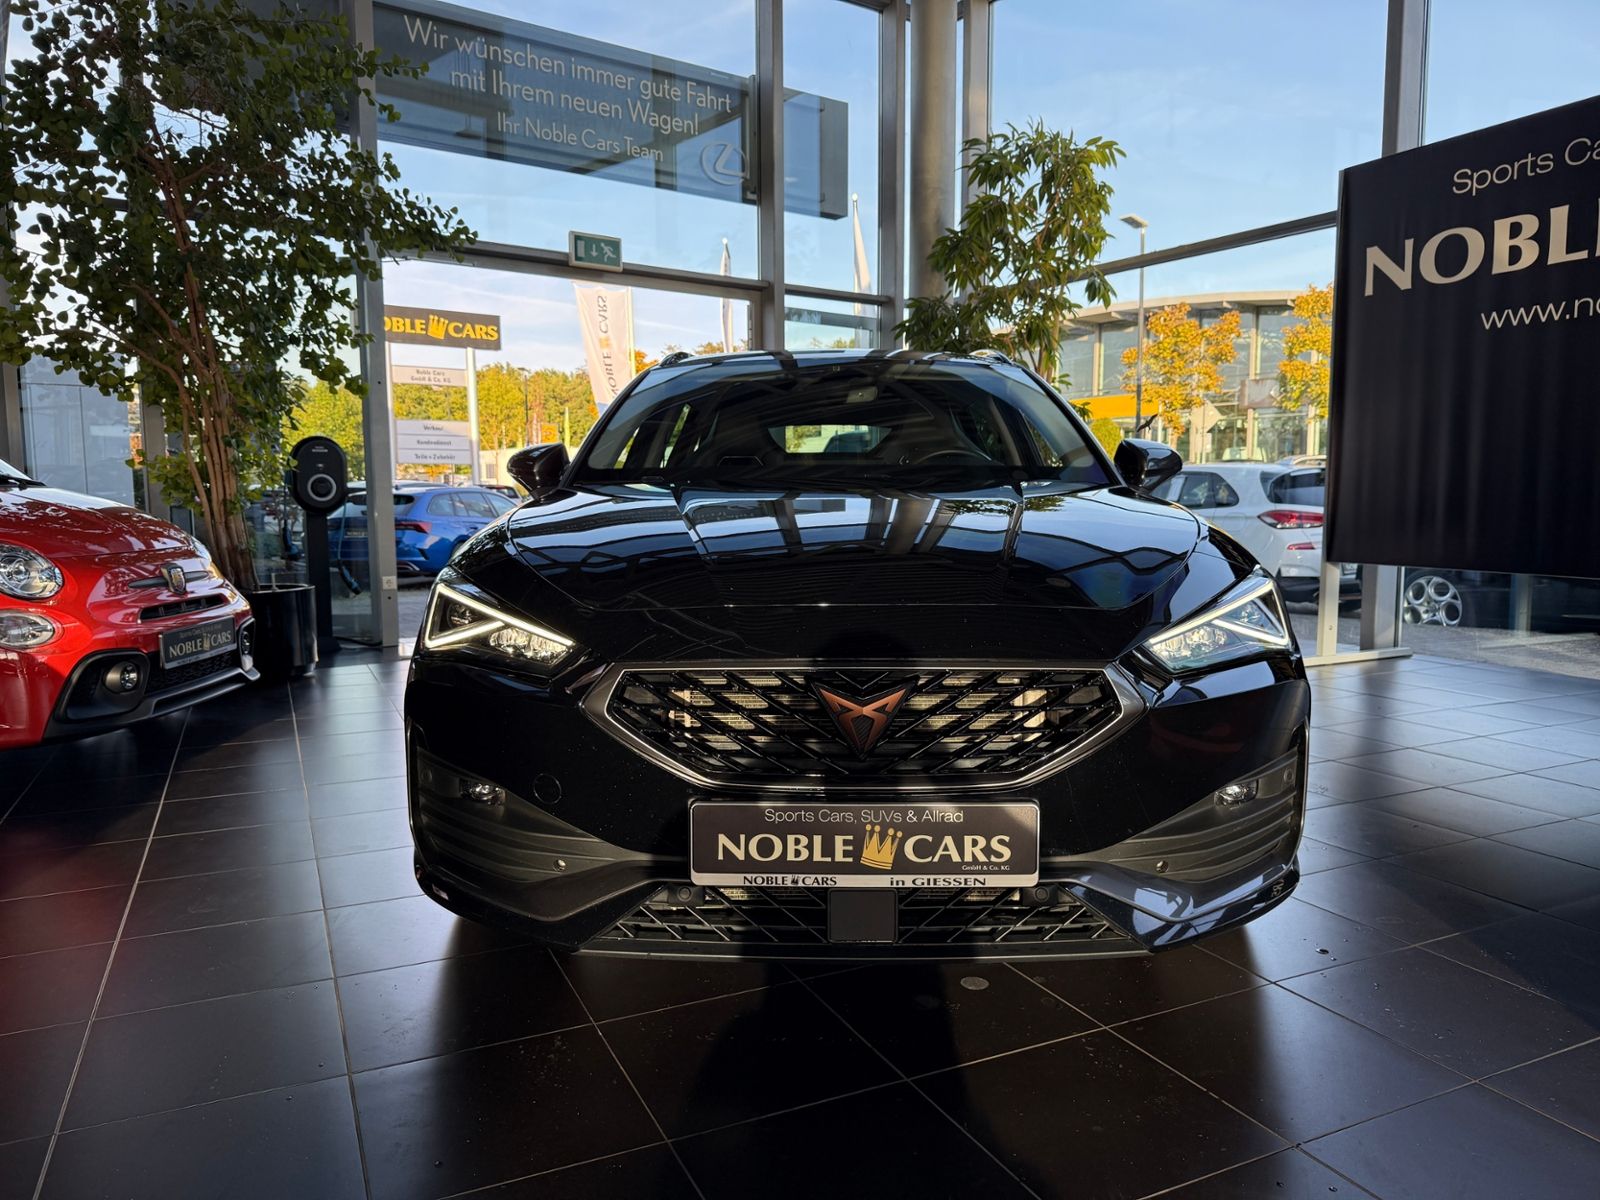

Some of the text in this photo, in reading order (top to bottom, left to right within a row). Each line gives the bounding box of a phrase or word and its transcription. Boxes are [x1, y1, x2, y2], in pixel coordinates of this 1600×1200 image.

[403, 15, 732, 113] Wir wünschen immer gute Fahrt
[451, 69, 698, 135] mit Ihrem neuen Wagen!
[497, 112, 663, 162] Ihr Noble Cars Team
[1452, 151, 1554, 196] Sports
[1364, 196, 1600, 297] NOBL
[447, 321, 499, 341] CARS
[169, 638, 202, 659] NOBLE
[211, 630, 232, 647] CARS
[764, 808, 964, 825] Sports Cars, SUVs & Allrad
[717, 833, 1012, 862] NOBLE CARS
[743, 875, 837, 886] NOBLE CARS
[890, 877, 986, 886] in GIESSEN
